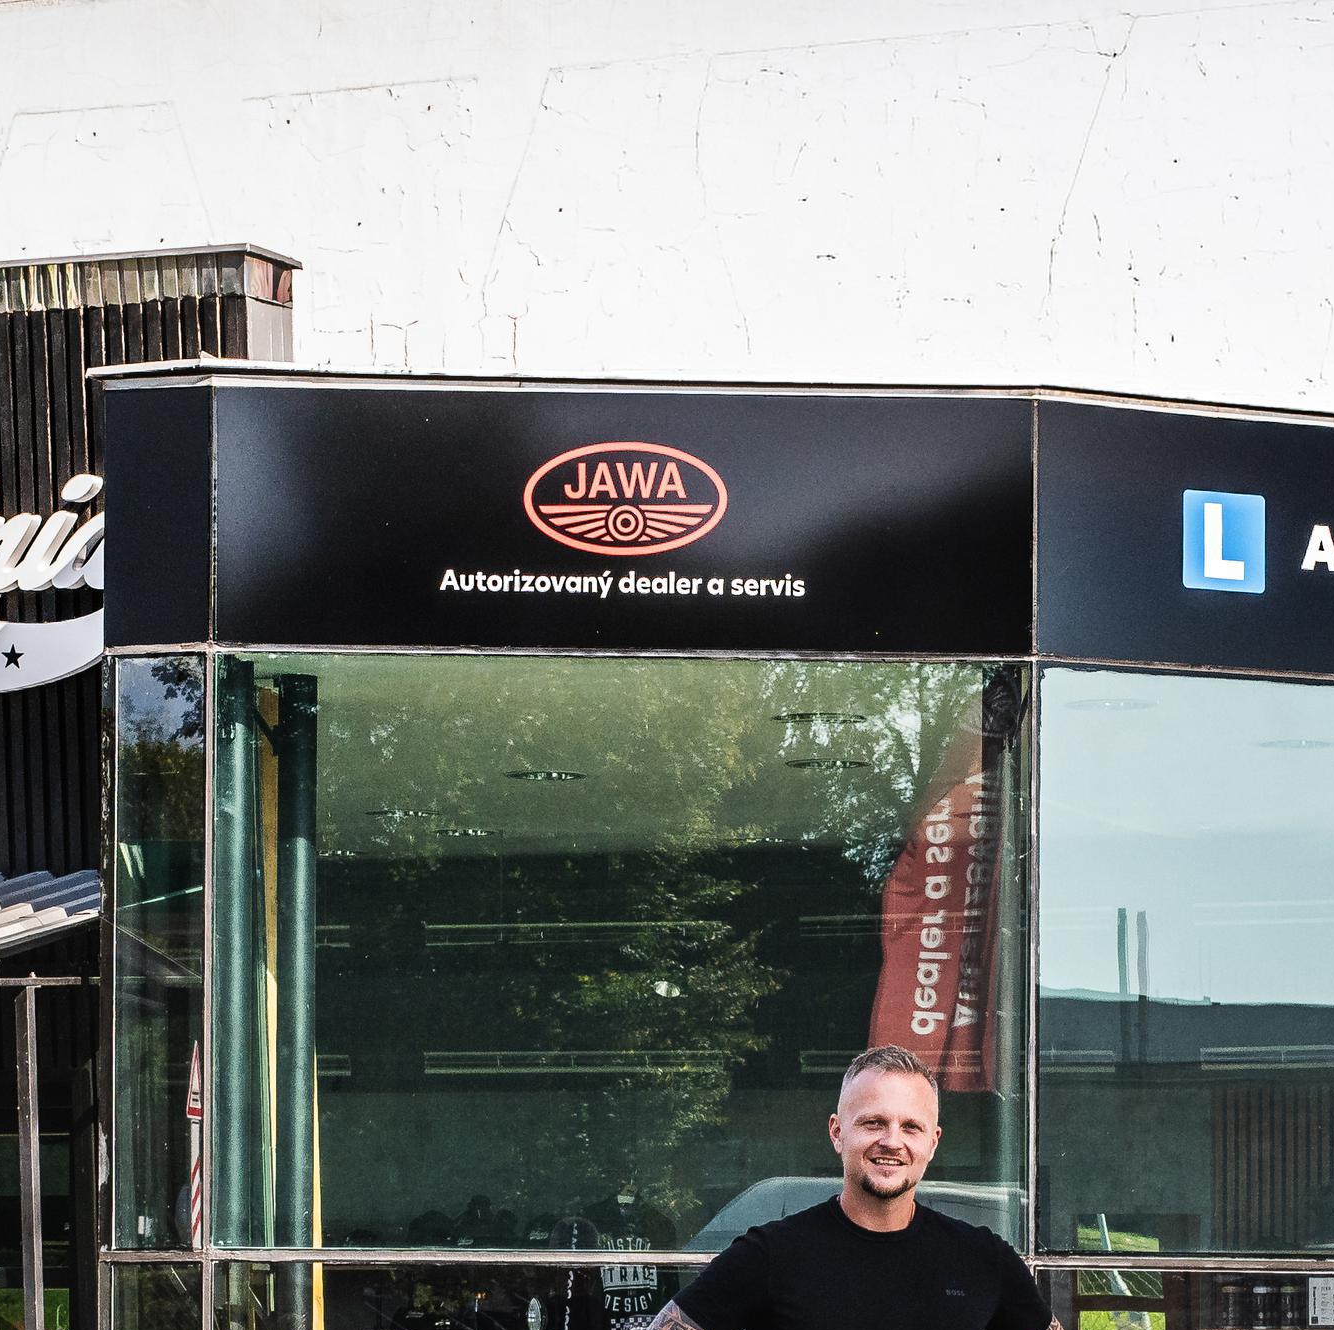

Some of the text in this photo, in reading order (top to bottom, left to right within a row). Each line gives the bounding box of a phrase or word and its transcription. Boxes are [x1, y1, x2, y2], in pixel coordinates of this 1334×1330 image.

[564, 461, 687, 499] JAWA
[1204, 502, 1245, 582] L
[439, 569, 806, 599] Autorizovaný dealer a servis
